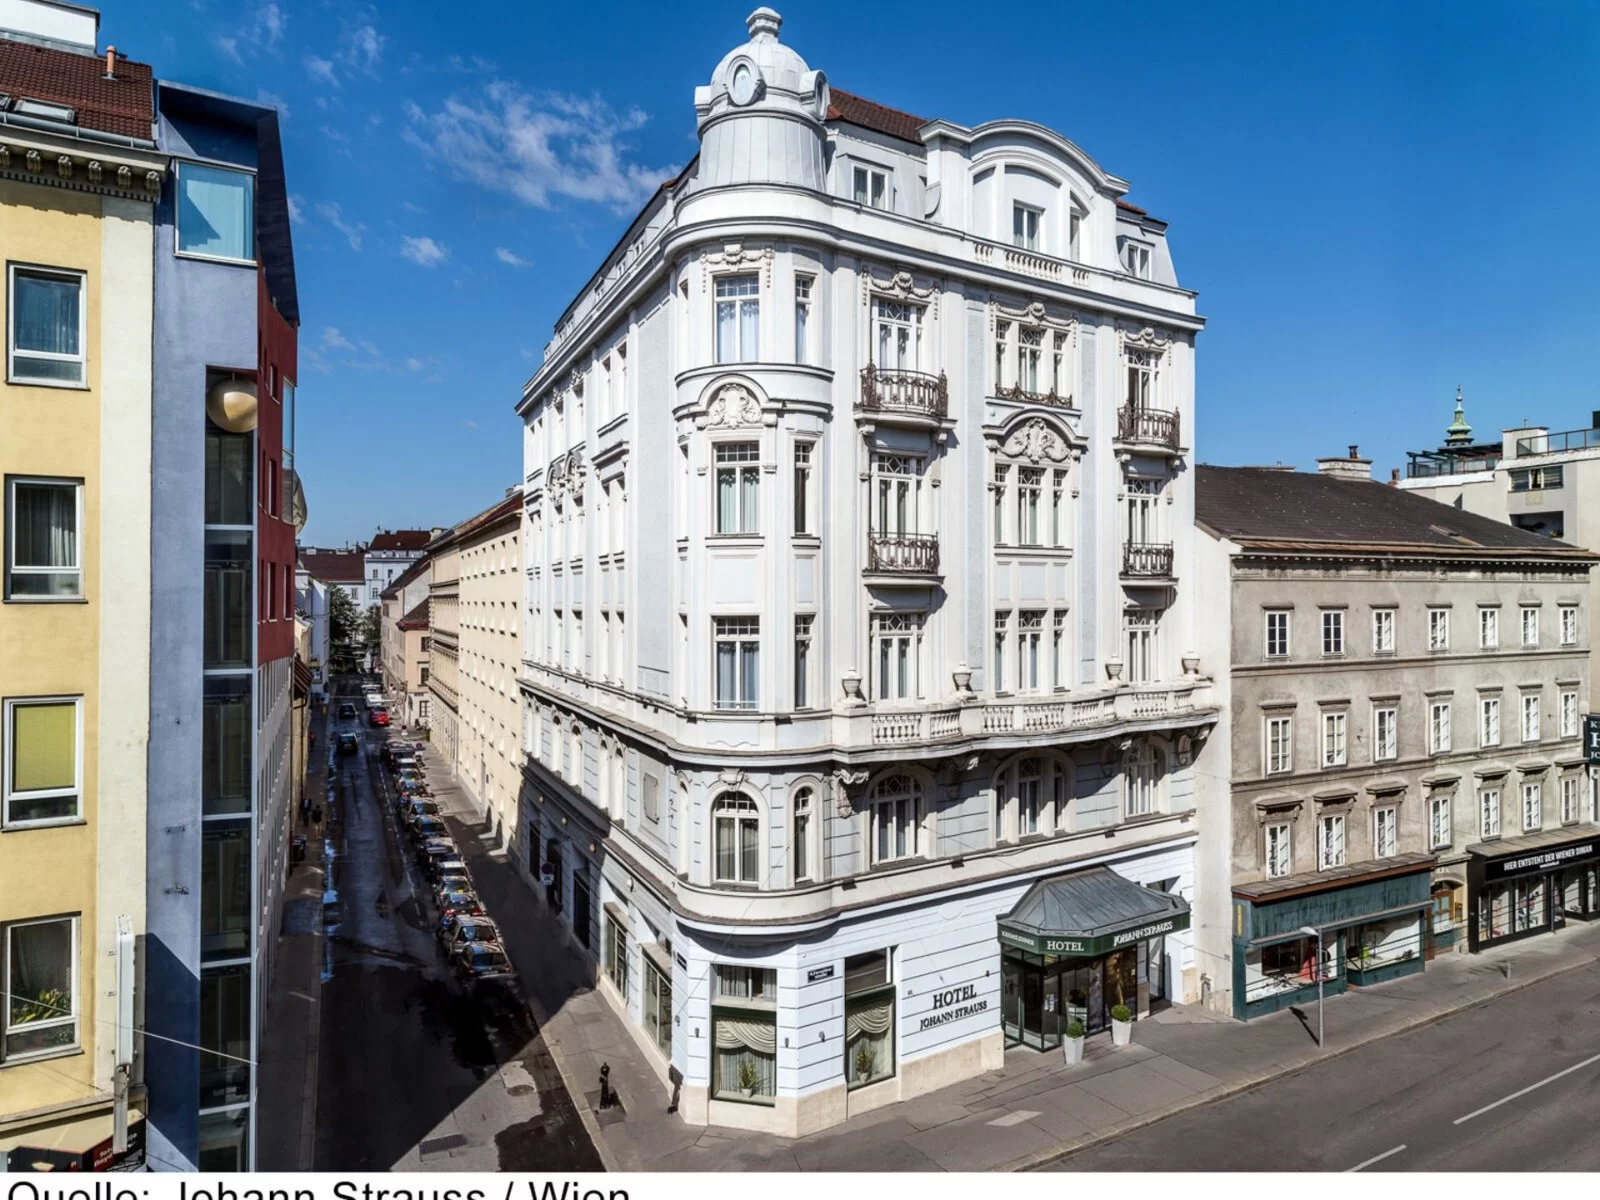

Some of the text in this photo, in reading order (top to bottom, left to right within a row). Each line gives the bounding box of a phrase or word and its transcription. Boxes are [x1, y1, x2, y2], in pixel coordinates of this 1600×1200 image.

[1503, 860, 1517, 871] HIER
[1544, 852, 1555, 863] DER
[1555, 848, 1575, 860] WIENER
[1047, 940, 1084, 951] HOTEL
[1113, 921, 1173, 947] JOHANN STRAUSS
[932, 984, 977, 1010] HOTEL
[920, 1000, 988, 1031] JOHANN STRAUSS
